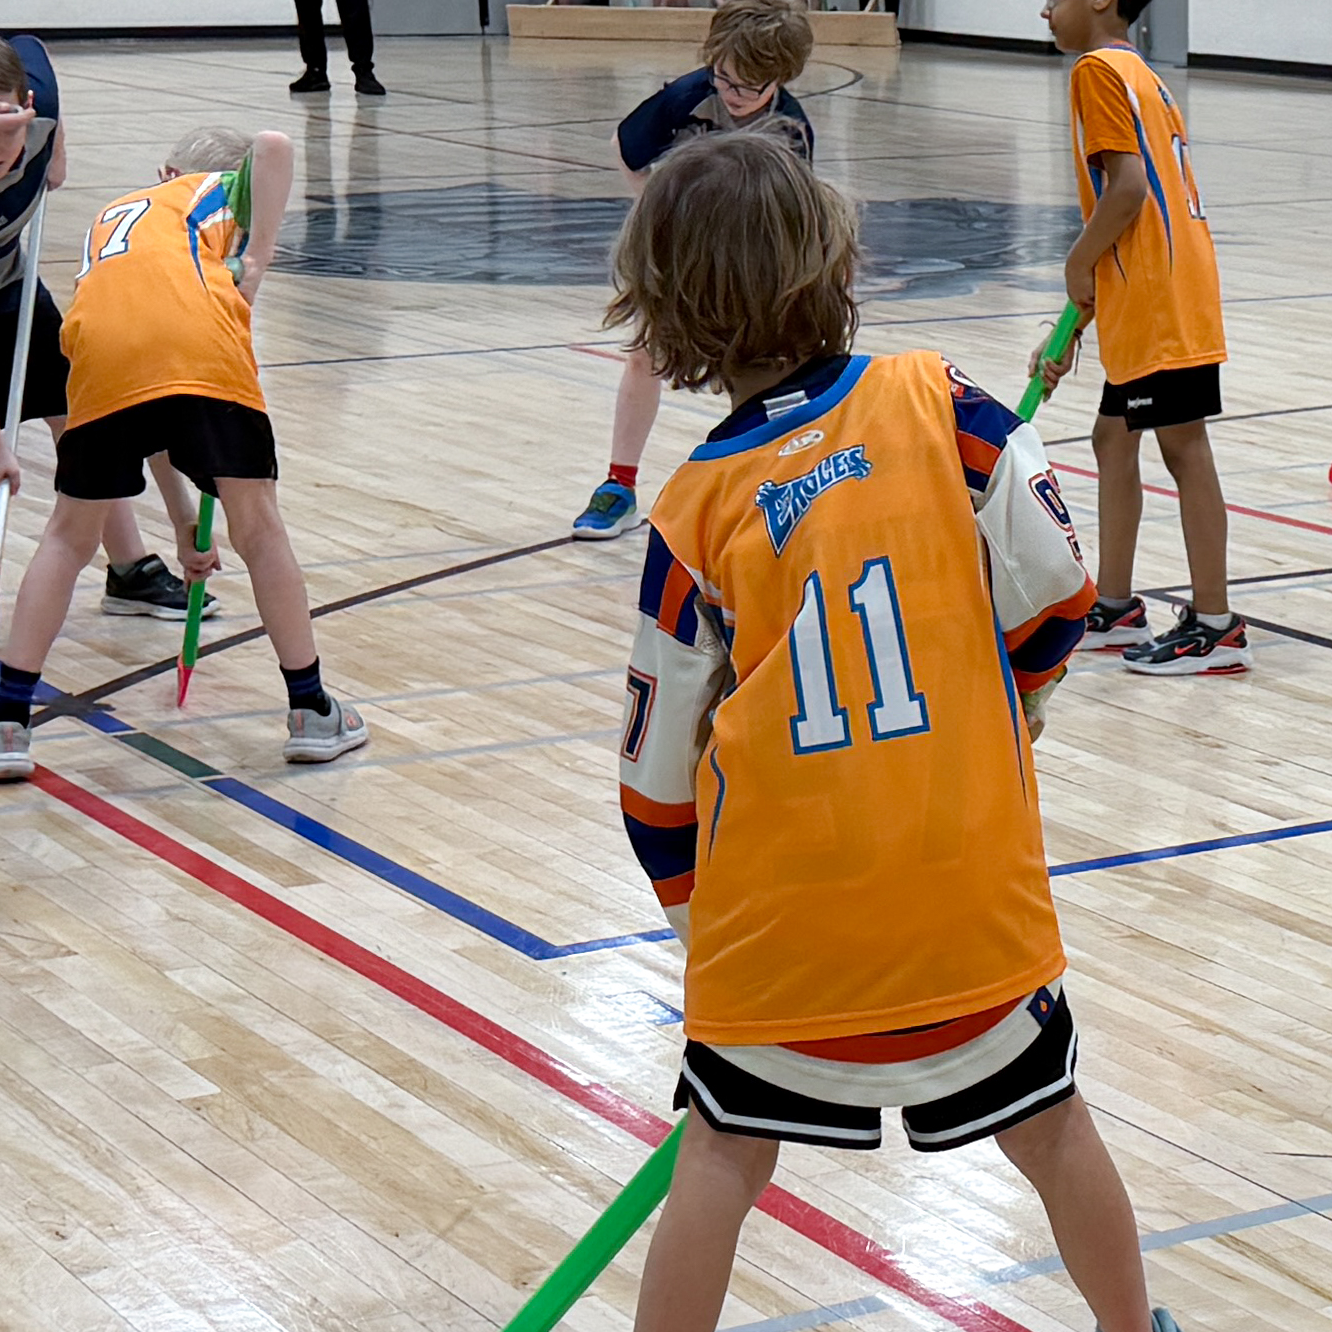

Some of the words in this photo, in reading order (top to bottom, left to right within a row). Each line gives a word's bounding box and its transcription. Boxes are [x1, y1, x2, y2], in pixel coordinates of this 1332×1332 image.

[98, 198, 151, 260] 7
[755, 444, 873, 558] EAGLES
[789, 556, 930, 755] 11
